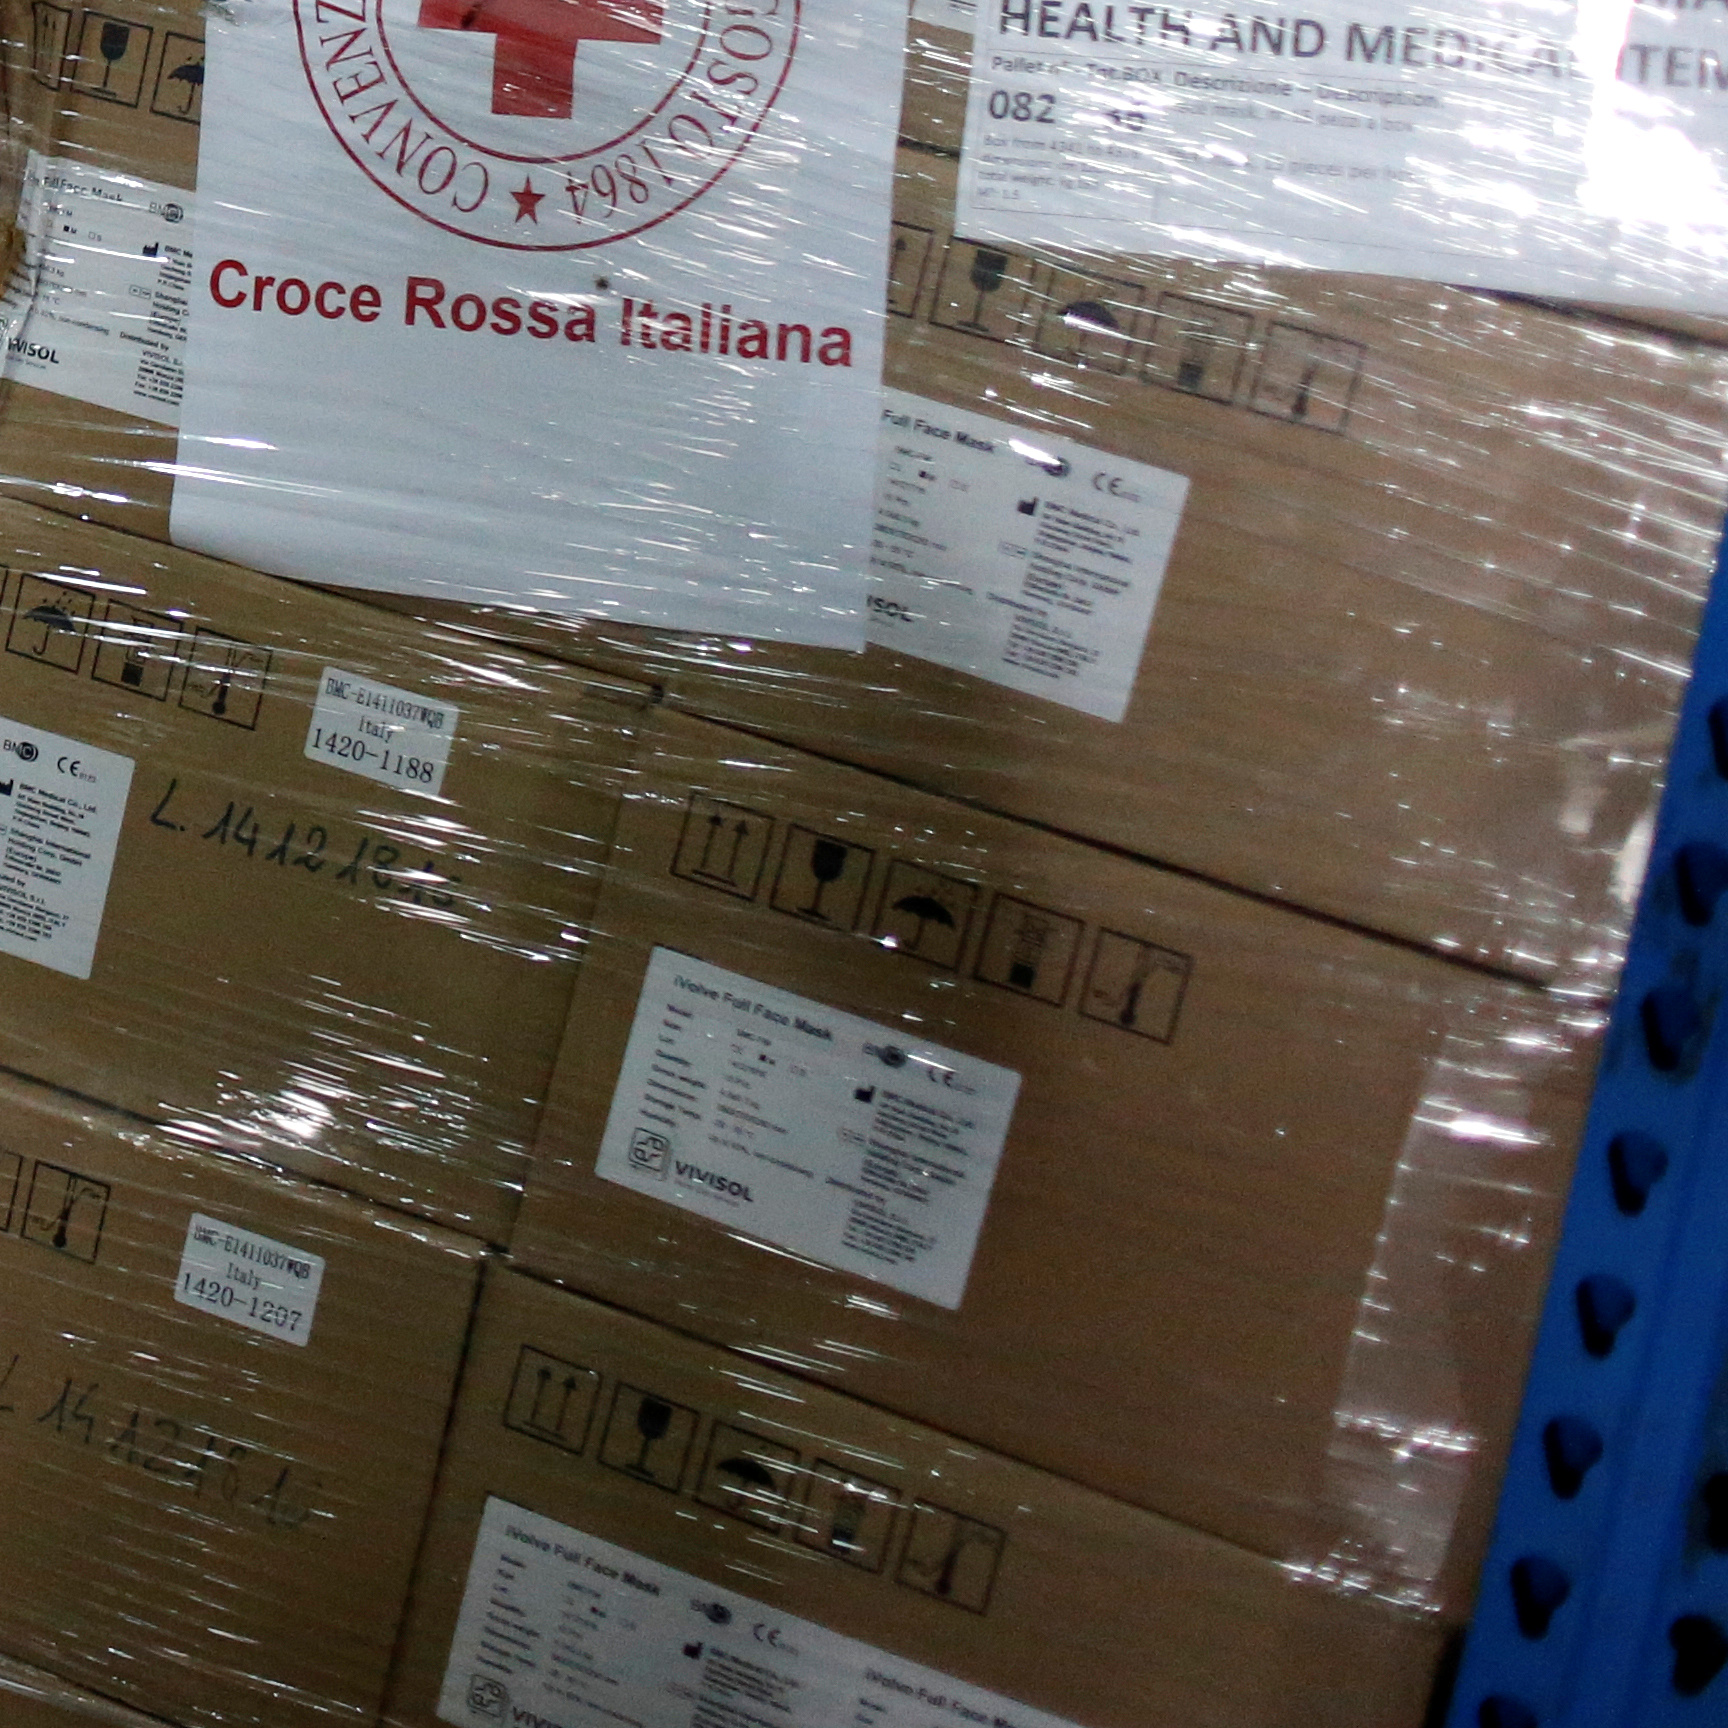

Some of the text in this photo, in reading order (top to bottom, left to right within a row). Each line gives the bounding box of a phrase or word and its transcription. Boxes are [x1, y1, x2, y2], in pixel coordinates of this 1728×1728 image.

[1209, 11, 1327, 58] AND
[989, 89, 1057, 125] 082
[565, 137, 675, 226] 1864
[209, 258, 854, 368] Croce Rossa Italiana
[912, 418, 952, 441] Face
[357, 715, 394, 744] Italy
[311, 727, 435, 784] 1420-1188
[674, 1159, 755, 1204] VIVISOL
[225, 1261, 262, 1291] Italy
[183, 1272, 303, 1332] 1420-1207
